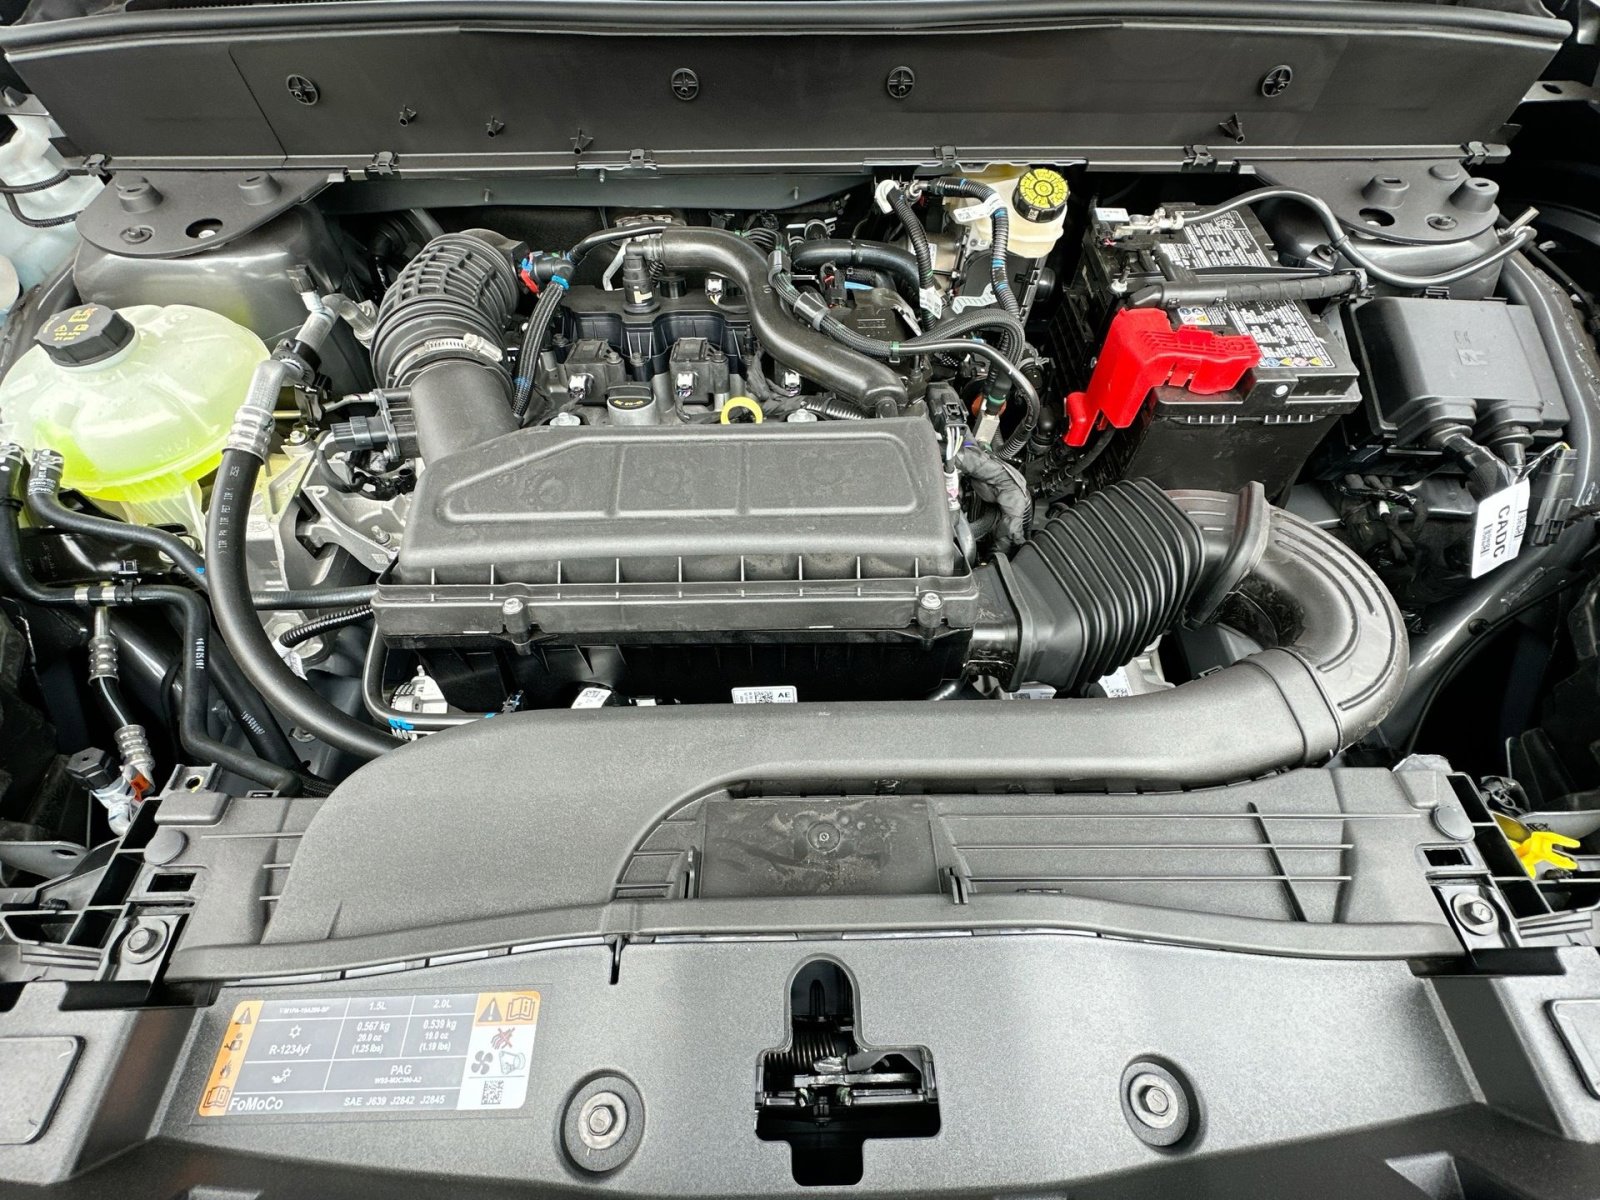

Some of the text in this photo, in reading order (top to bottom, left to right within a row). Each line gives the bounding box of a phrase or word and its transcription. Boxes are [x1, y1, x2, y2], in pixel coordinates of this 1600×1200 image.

[1493, 505, 1510, 558] CADC
[369, 1001, 387, 1011] 1.5L
[433, 999, 452, 1009] 2.0L
[356, 1021, 391, 1033] 0.567 kg
[423, 1019, 457, 1031] 0.539 kg
[268, 1043, 312, 1057] R-1234yf
[352, 1043, 384, 1055] (1.25 lbs)
[419, 1042, 452, 1053] (1.19 lbs)
[390, 1064, 412, 1075] PAG
[228, 1096, 284, 1111] FoMoCo
[344, 1094, 446, 1107] SAE J639 J2842 J2845
